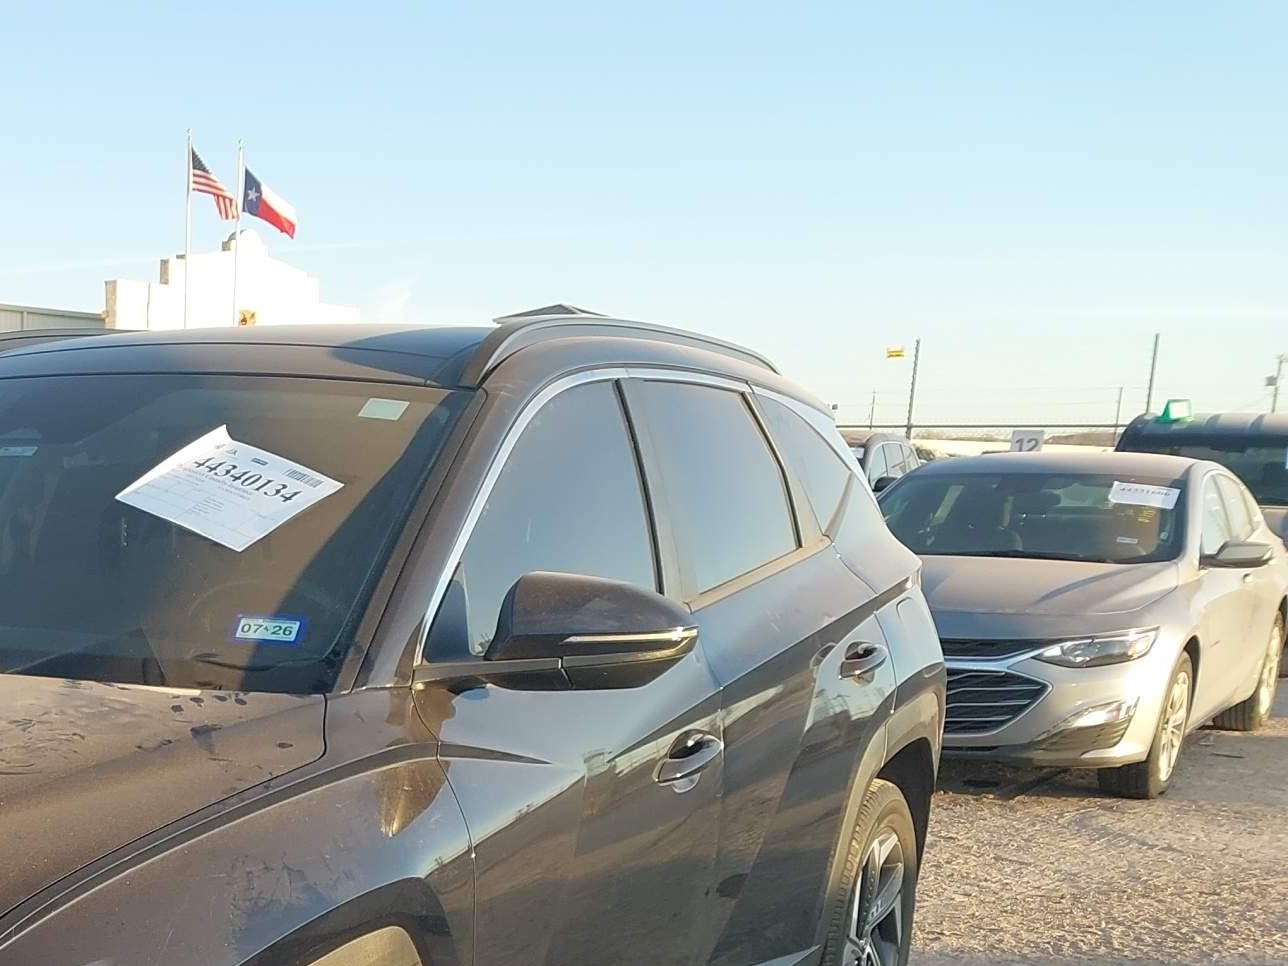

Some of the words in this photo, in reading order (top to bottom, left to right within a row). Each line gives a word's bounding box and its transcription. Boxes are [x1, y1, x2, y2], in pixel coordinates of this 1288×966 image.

[1015, 437, 1039, 452] 12
[194, 456, 303, 503] 44340134
[240, 623, 263, 634] 07
[270, 625, 294, 637] 26
